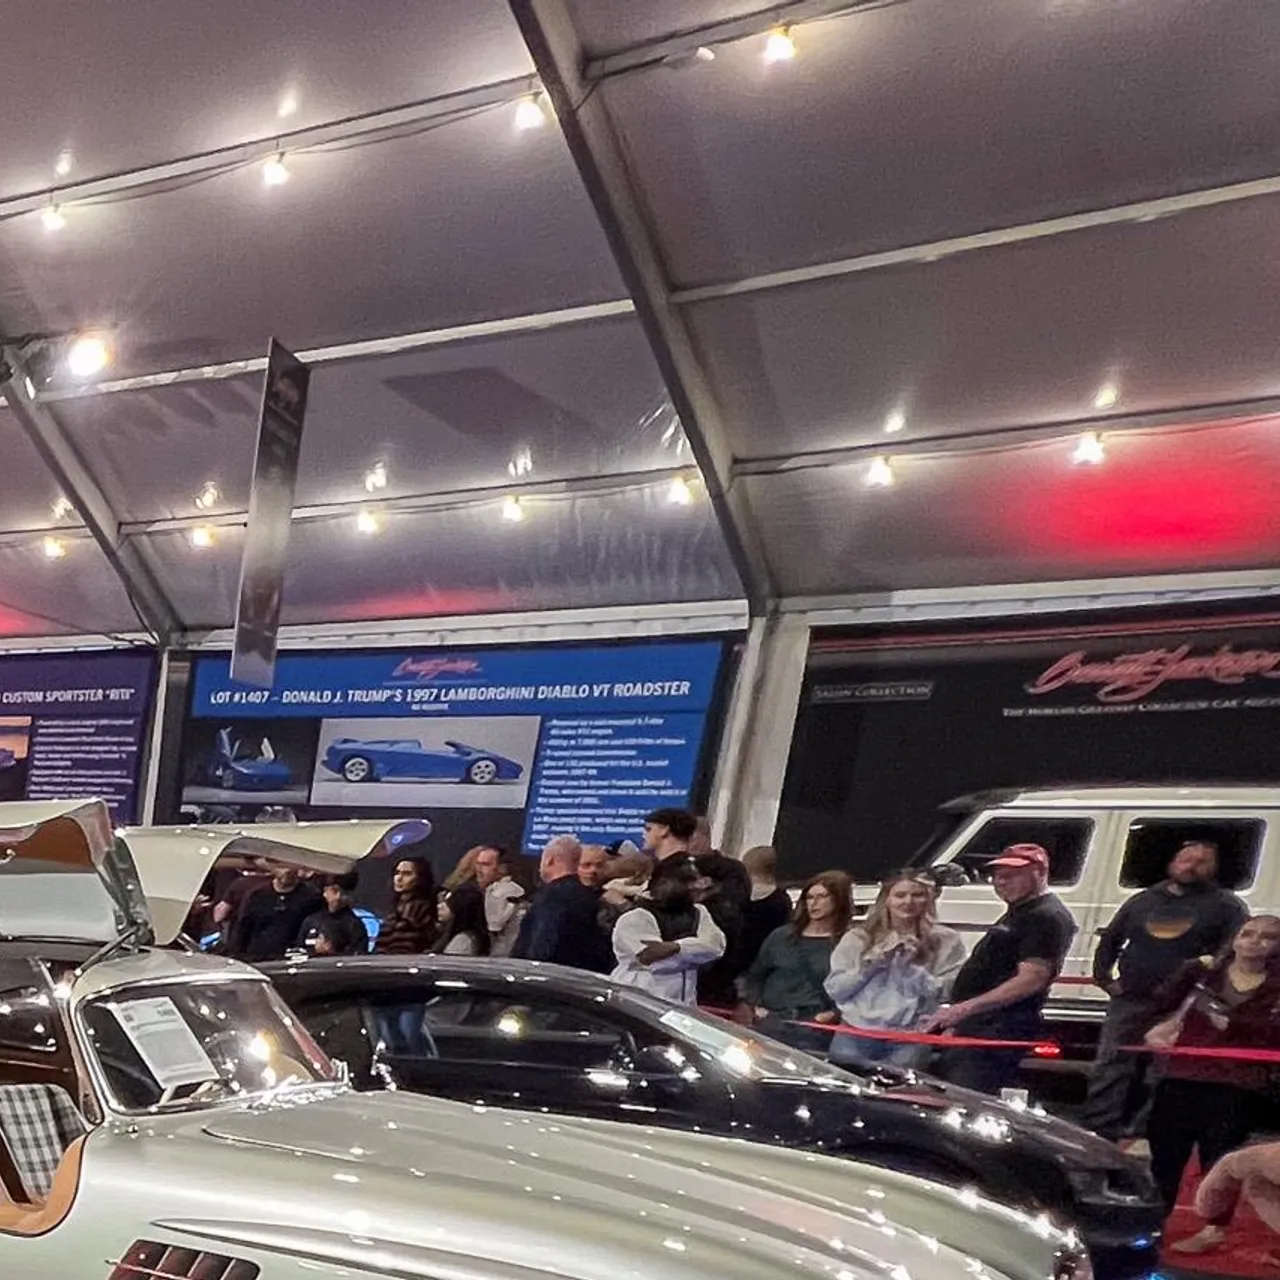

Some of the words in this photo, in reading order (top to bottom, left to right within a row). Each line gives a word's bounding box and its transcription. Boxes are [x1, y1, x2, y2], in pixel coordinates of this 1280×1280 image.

[211, 691, 231, 704] LOT
[282, 690, 331, 703] DONALD
[347, 689, 402, 703] TRUMP'S
[406, 688, 438, 702] 1997
[440, 685, 535, 701] LAMBORGHINI
[537, 684, 589, 699] DIABLO
[591, 683, 611, 697] VT
[613, 681, 690, 697] ROADSTER
